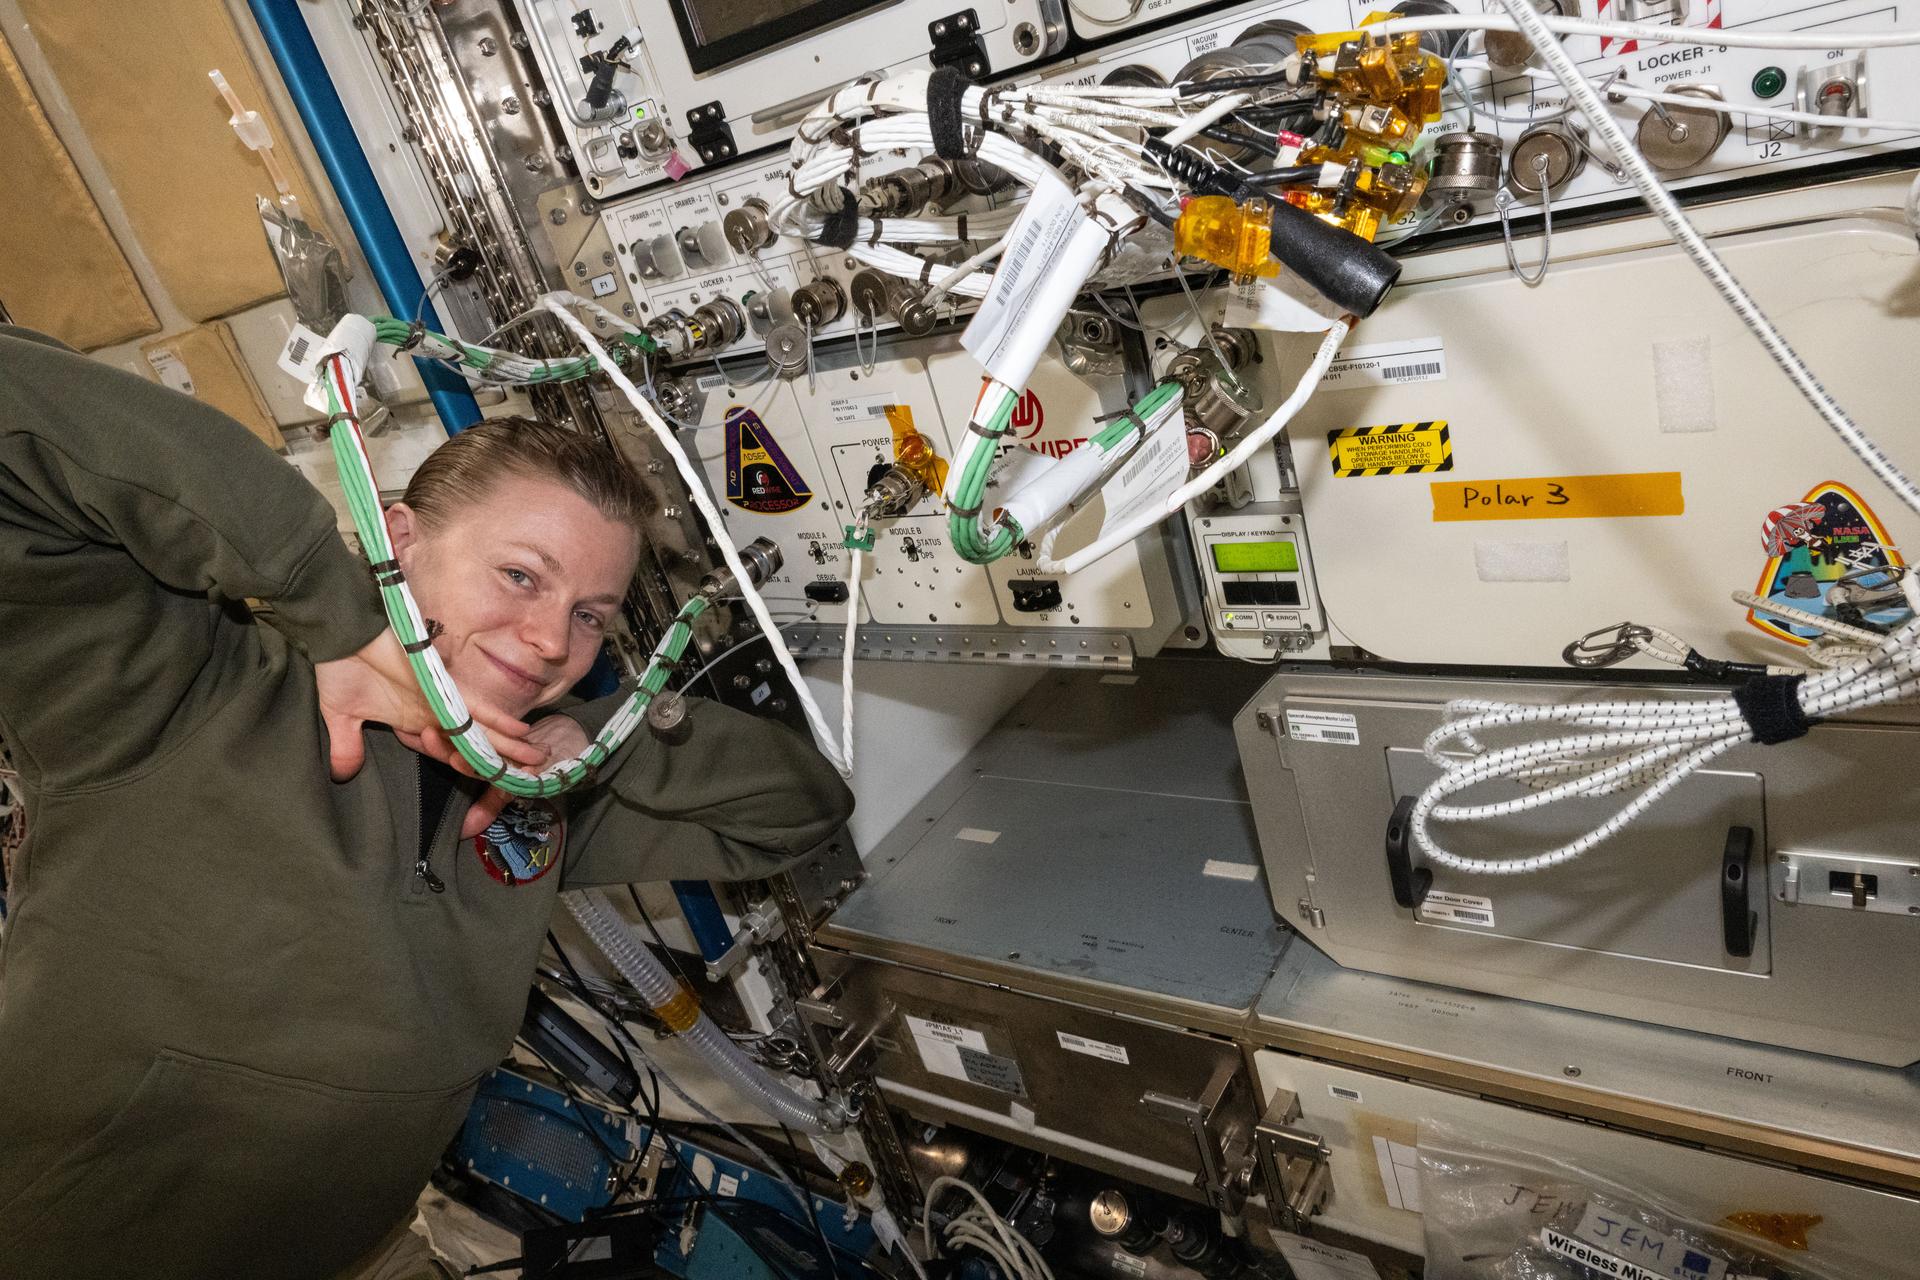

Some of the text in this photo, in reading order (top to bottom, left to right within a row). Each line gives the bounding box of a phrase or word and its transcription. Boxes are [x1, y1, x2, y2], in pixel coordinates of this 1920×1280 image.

[1192, 32, 1217, 45] VACUUM
[1195, 41, 1216, 52] WASTE
[1638, 46, 1704, 72] LOCKER
[1827, 49, 1844, 60] ON
[1654, 69, 1692, 84] POWER
[1701, 65, 1711, 74] J1
[1427, 122, 1459, 135] POWER
[1759, 141, 1782, 159] J2
[640, 164, 660, 176] POWER
[764, 169, 784, 182] SAMS
[674, 197, 696, 209] DRAWER
[629, 210, 650, 221] DRAWER
[600, 281, 609, 290] F1
[700, 275, 725, 289] LOCKER
[728, 275, 733, 283] 3
[1330, 373, 1342, 381] 011
[862, 437, 891, 447] POWER
[1359, 433, 1416, 445] WARNING
[1351, 455, 1392, 463] OPERATIONS
[1393, 453, 1418, 461] BELOW
[1356, 450, 1387, 458] STOWAGE
[1387, 459, 1431, 467] PROTECTION
[1464, 482, 1570, 509] Polar 3
[797, 532, 821, 540] MODULE
[889, 527, 922, 536] MODULE B
[1833, 527, 1870, 536] NASA
[822, 542, 844, 550] STATUS
[916, 538, 942, 546] STATUS
[1462, 897, 1483, 906] Cover
[1220, 926, 1255, 938] CENTER
[1726, 1067, 1774, 1084] FRONT
[1593, 1215, 1664, 1260] JEM
[1548, 1232, 1618, 1273] Wireless
